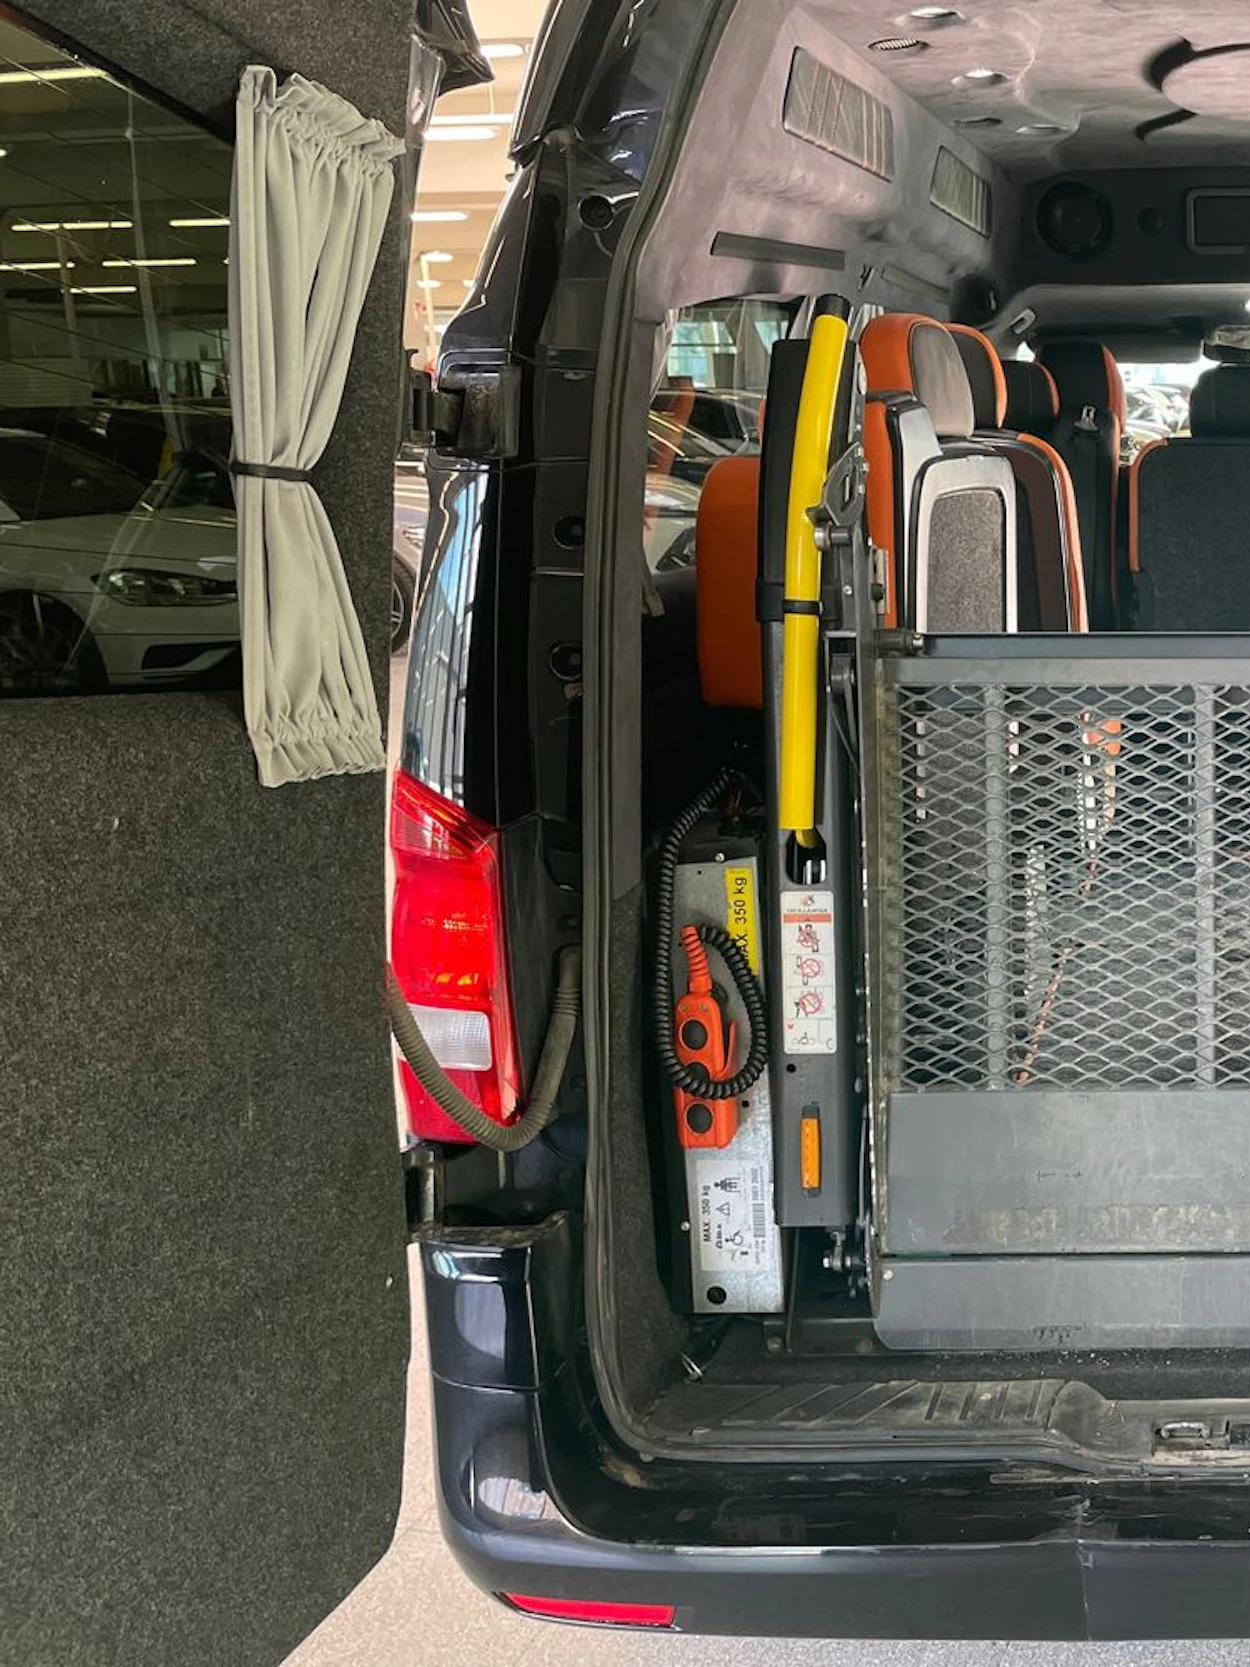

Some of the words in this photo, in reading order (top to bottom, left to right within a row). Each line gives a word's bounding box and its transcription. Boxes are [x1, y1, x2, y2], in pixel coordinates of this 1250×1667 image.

[733, 877, 747, 894] kg
[733, 899, 747, 924] 350
[702, 1185, 711, 1196] kg
[701, 1198, 710, 1215] 350
